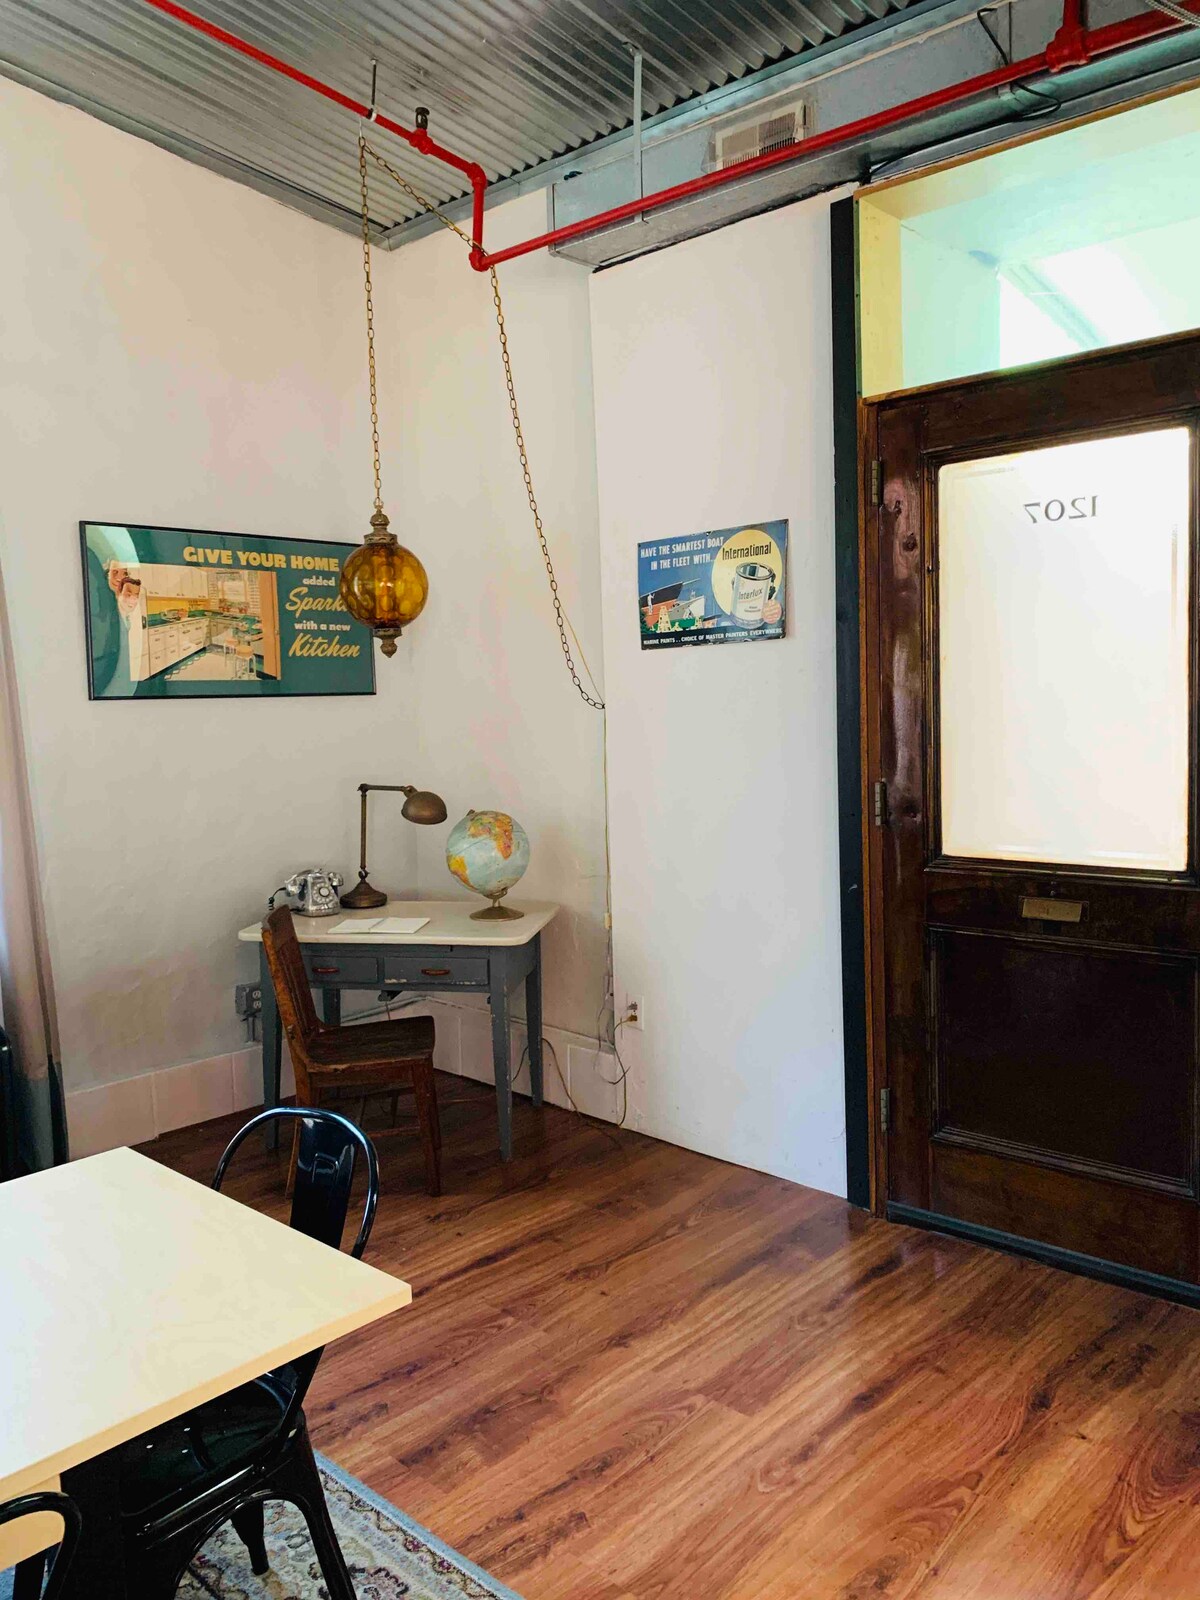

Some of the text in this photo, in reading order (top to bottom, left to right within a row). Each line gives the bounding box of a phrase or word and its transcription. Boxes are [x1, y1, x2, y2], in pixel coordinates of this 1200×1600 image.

[641, 536, 724, 558] HAVE THE SMARTEST BOAT
[722, 541, 772, 561] International
[183, 546, 340, 572] GIVE YOUR HOME
[650, 561, 658, 571] IN
[660, 558, 671, 569] THE
[672, 556, 691, 568] FLEET
[302, 575, 336, 587] added
[294, 619, 351, 632] with a new
[681, 634, 698, 642] CHOICE
[705, 632, 725, 640] MASTER
[725, 630, 749, 638] PAINTERS
[749, 627, 783, 636] EVERYWHERE
[288, 632, 361, 658] Kitchen
